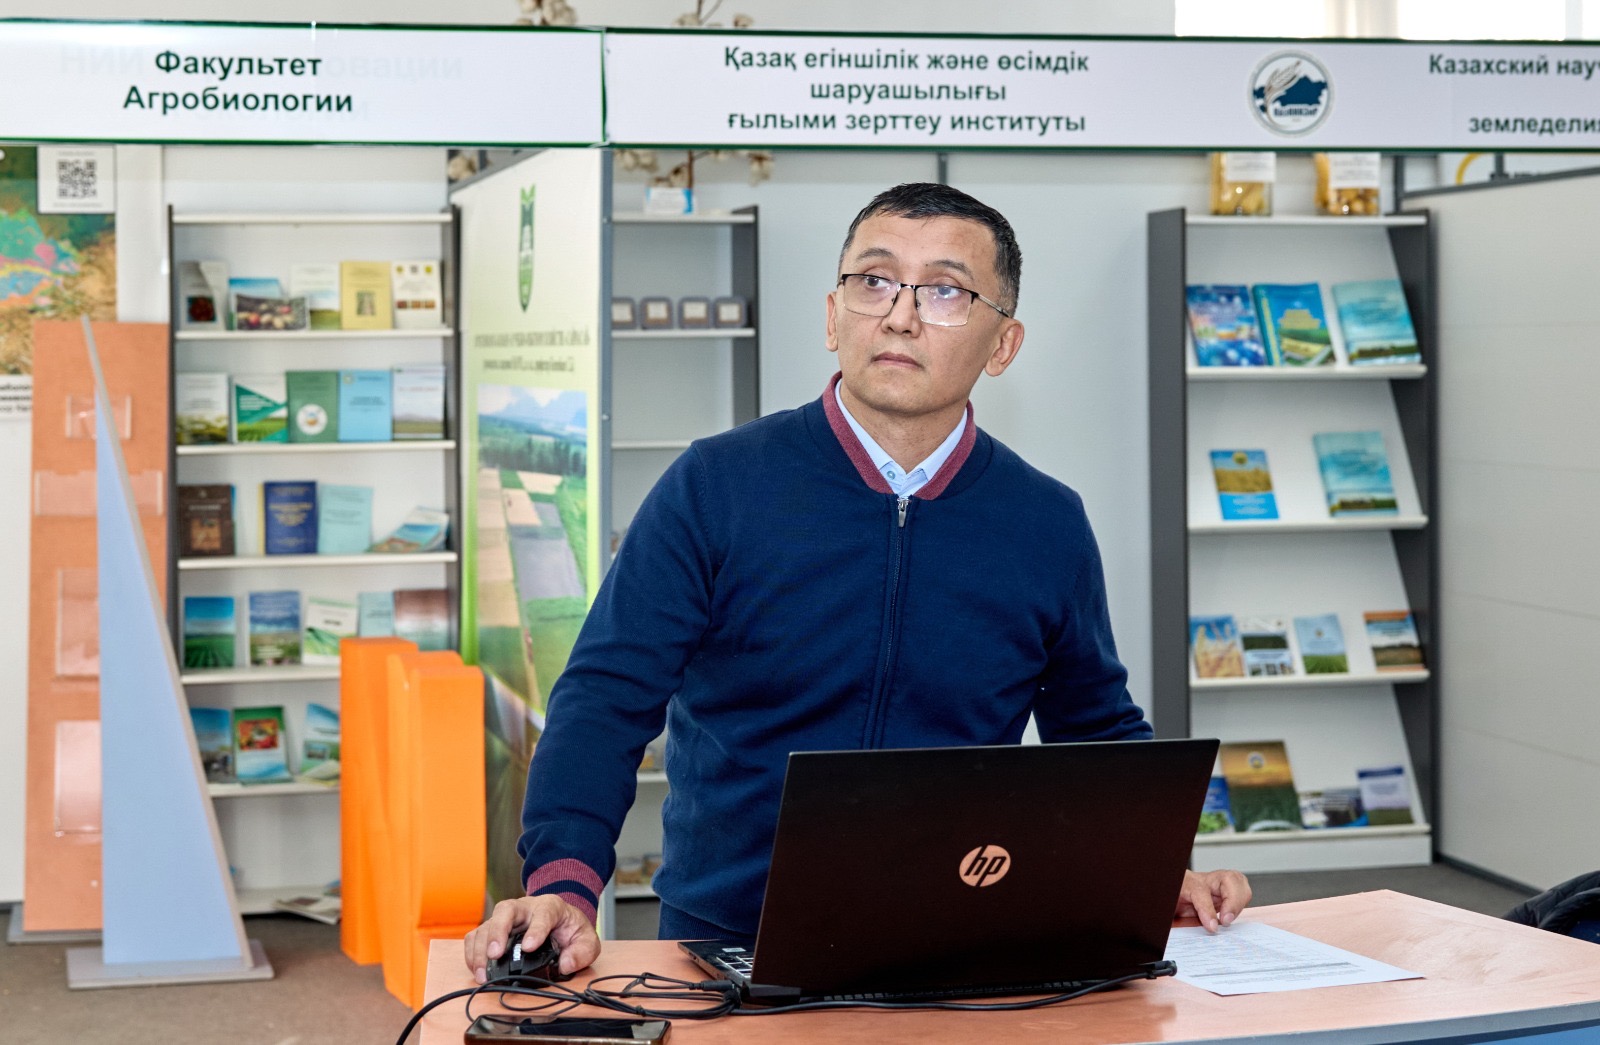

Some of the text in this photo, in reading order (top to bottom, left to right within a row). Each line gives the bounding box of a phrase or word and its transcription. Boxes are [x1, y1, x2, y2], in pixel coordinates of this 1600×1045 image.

[154, 50, 323, 80] Факультет
[725, 46, 1089, 74] Қазақ егіншілік және өсімдік
[1428, 53, 1600, 81] Казахский нау
[123, 85, 352, 115] Агробиологии
[810, 82, 1006, 104] шаруашылығы
[728, 112, 1085, 135] ғылыми зерттеу институты
[1469, 116, 1600, 136] земледели
[962, 845, 1008, 887] hp
